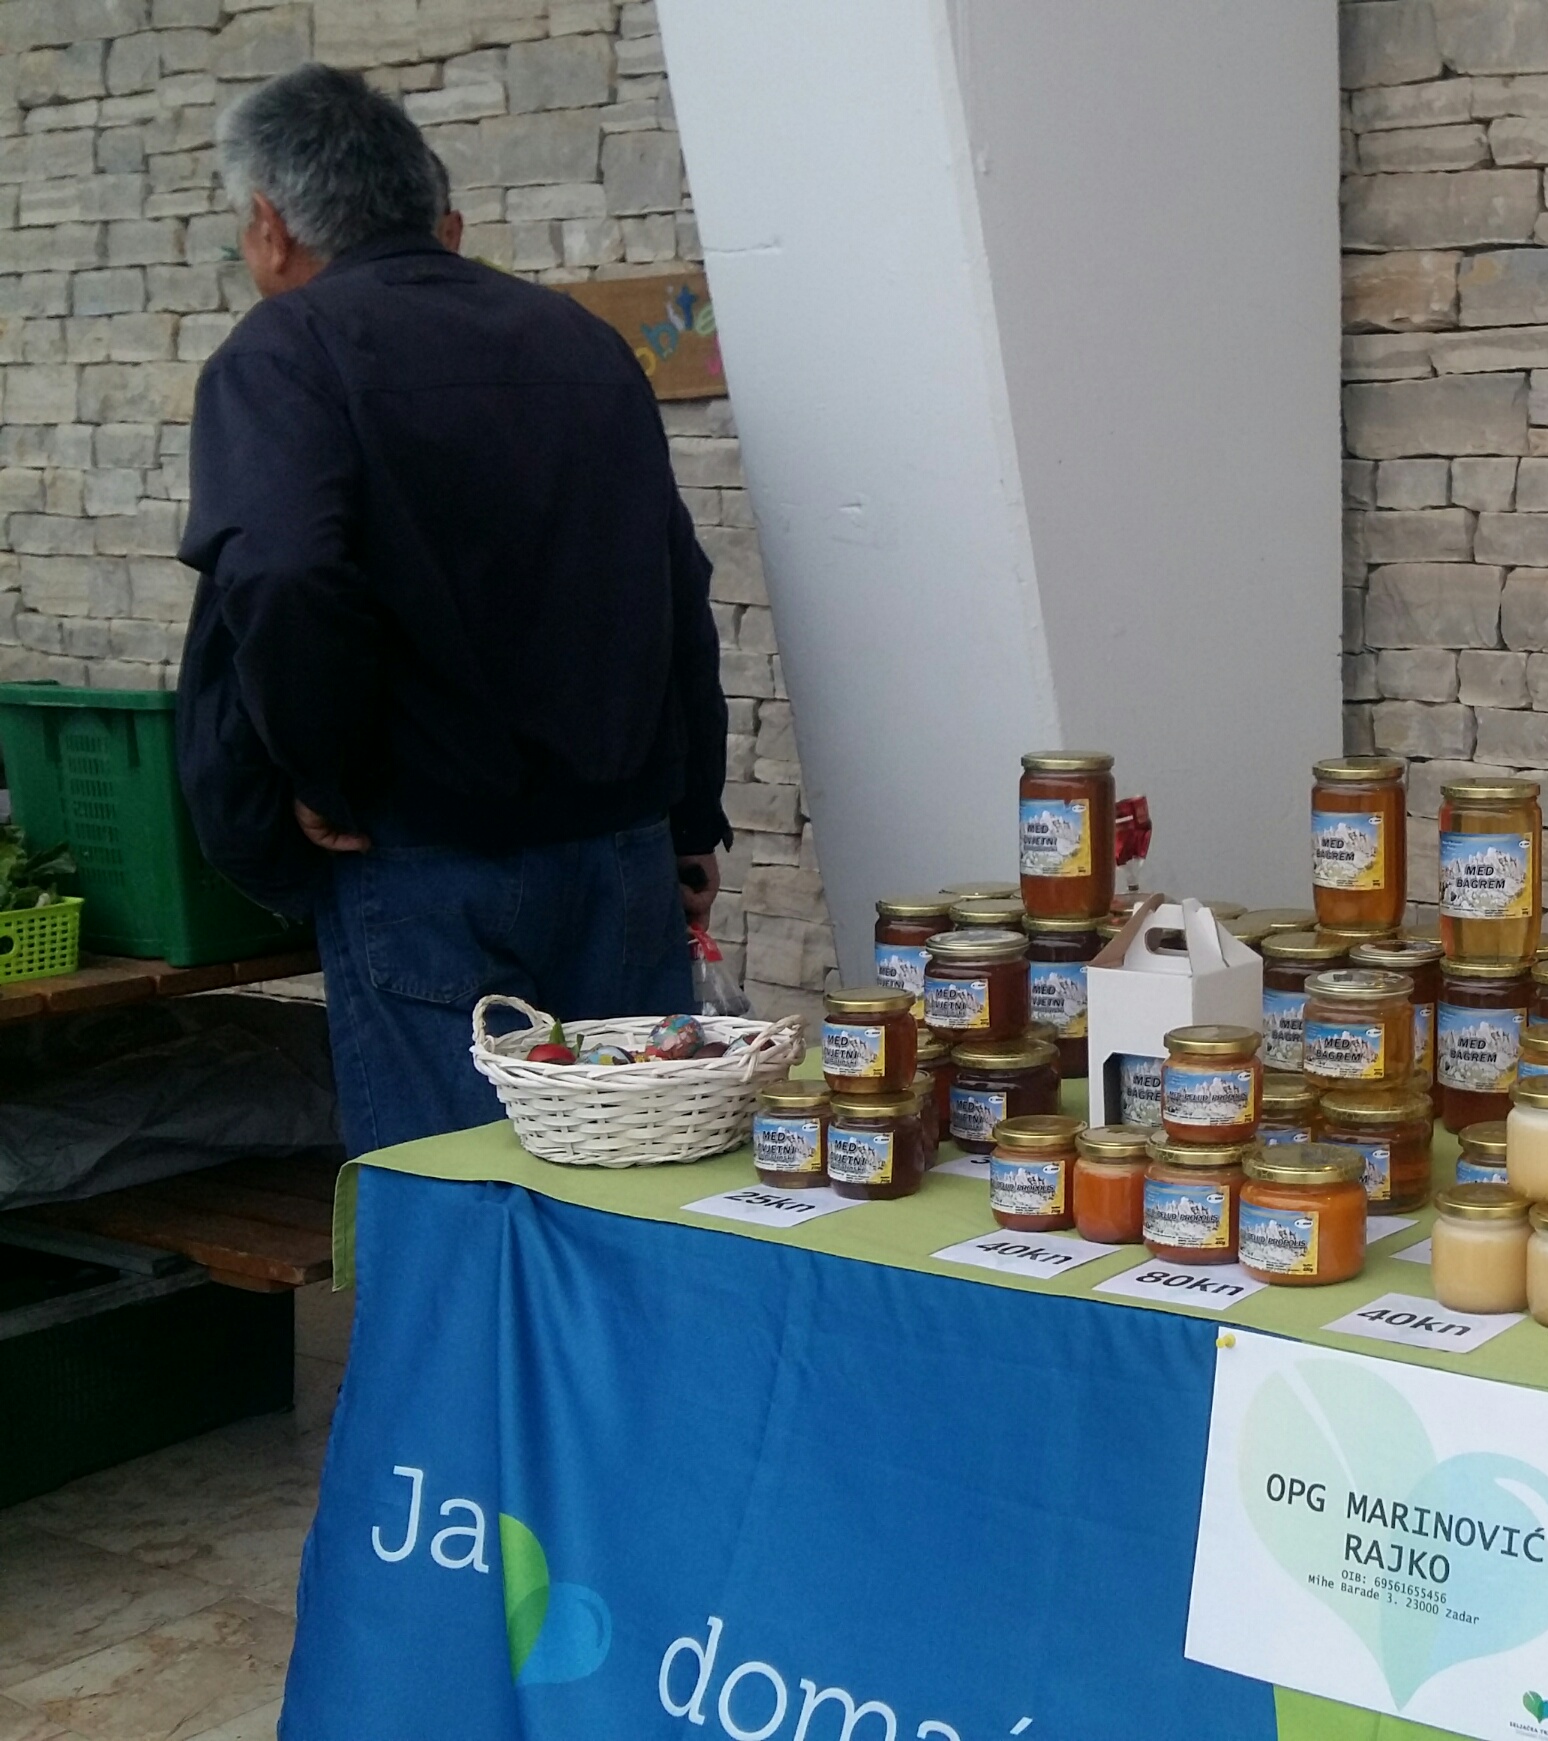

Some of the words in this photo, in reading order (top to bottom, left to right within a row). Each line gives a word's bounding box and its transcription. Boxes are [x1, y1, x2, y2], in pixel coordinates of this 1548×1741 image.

[1027, 824, 1049, 834] MED
[1321, 838, 1344, 849] MED
[1316, 849, 1355, 861] BAGREM
[1465, 865, 1494, 876] MED
[1456, 879, 1505, 889] BAGREM
[936, 988, 957, 998] MED
[1032, 985, 1056, 995] MED
[827, 1035, 849, 1046] MED
[1324, 1038, 1350, 1049] MED
[1458, 1038, 1486, 1050] MED
[1316, 1049, 1361, 1061] BAGREM
[1450, 1049, 1497, 1063] BAGREM
[1133, 1075, 1161, 1088] MED
[762, 1131, 786, 1142] MED
[835, 1140, 857, 1152] MED
[723, 1191, 816, 1214] 25kn
[1180, 1213, 1220, 1223] PROPOLIS
[1268, 1236, 1307, 1247] PROPOLIS
[975, 1241, 1073, 1266] 40kn
[1135, 1271, 1245, 1297] 80kn
[1356, 1308, 1472, 1337] 40kn
[371, 1465, 490, 1574] Ja
[1266, 1473, 1326, 1513] OPG
[1347, 1490, 1546, 1564] MARINOVIĆ
[1344, 1533, 1450, 1585] RAJKO
[1341, 1569, 1367, 1585] OIB:
[1374, 1576, 1447, 1604] 69561655456
[1308, 1574, 1335, 1589] Mihe
[1341, 1582, 1380, 1600] Barade
[1405, 1598, 1440, 1615] 23000
[1509, 1721, 1538, 1733] SELJAČKA
